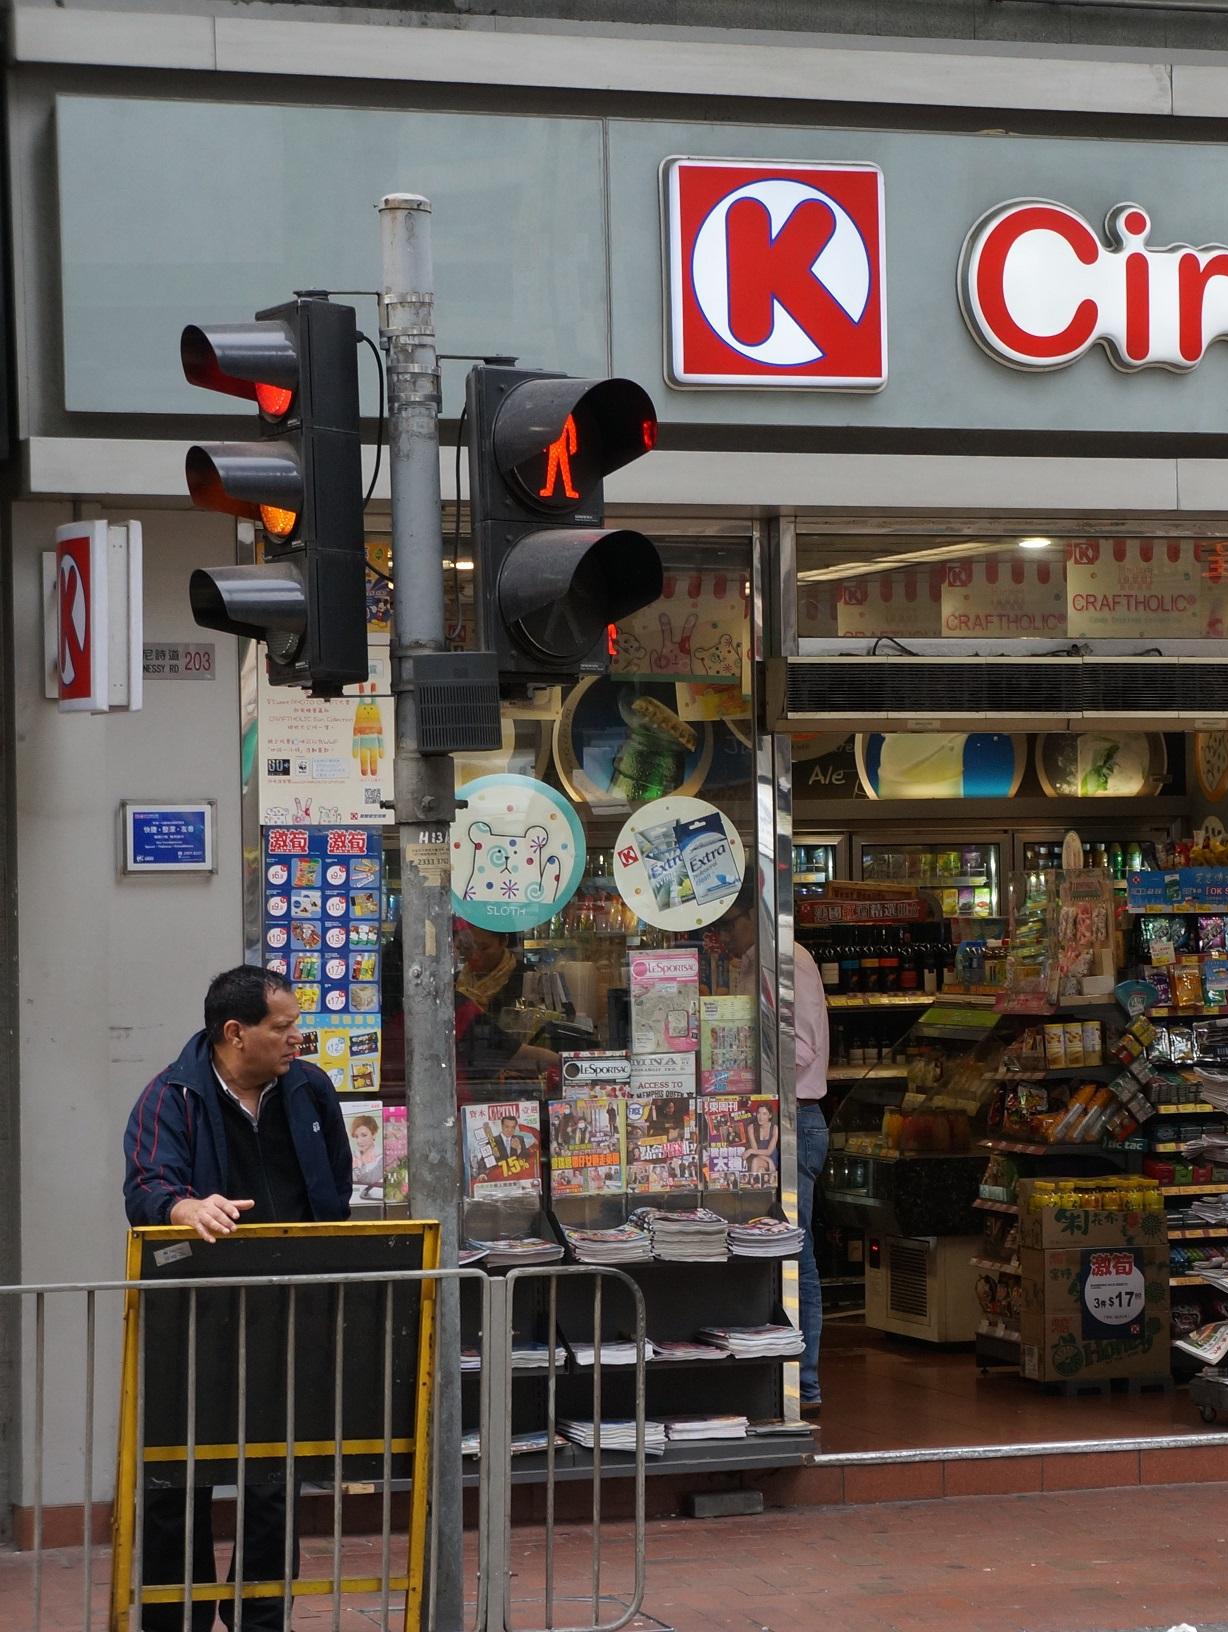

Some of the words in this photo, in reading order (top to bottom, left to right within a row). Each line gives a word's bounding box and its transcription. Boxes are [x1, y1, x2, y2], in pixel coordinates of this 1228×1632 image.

[708, 186, 868, 362] K
[169, 664, 179, 674] RD
[184, 651, 212, 672] 203
[690, 844, 726, 873] Extra
[486, 905, 526, 917] SLOTH
[638, 1081, 668, 1090] ACCESS
[1125, 1141, 1144, 1150] tac
[498, 1155, 530, 1178] 7.5%
